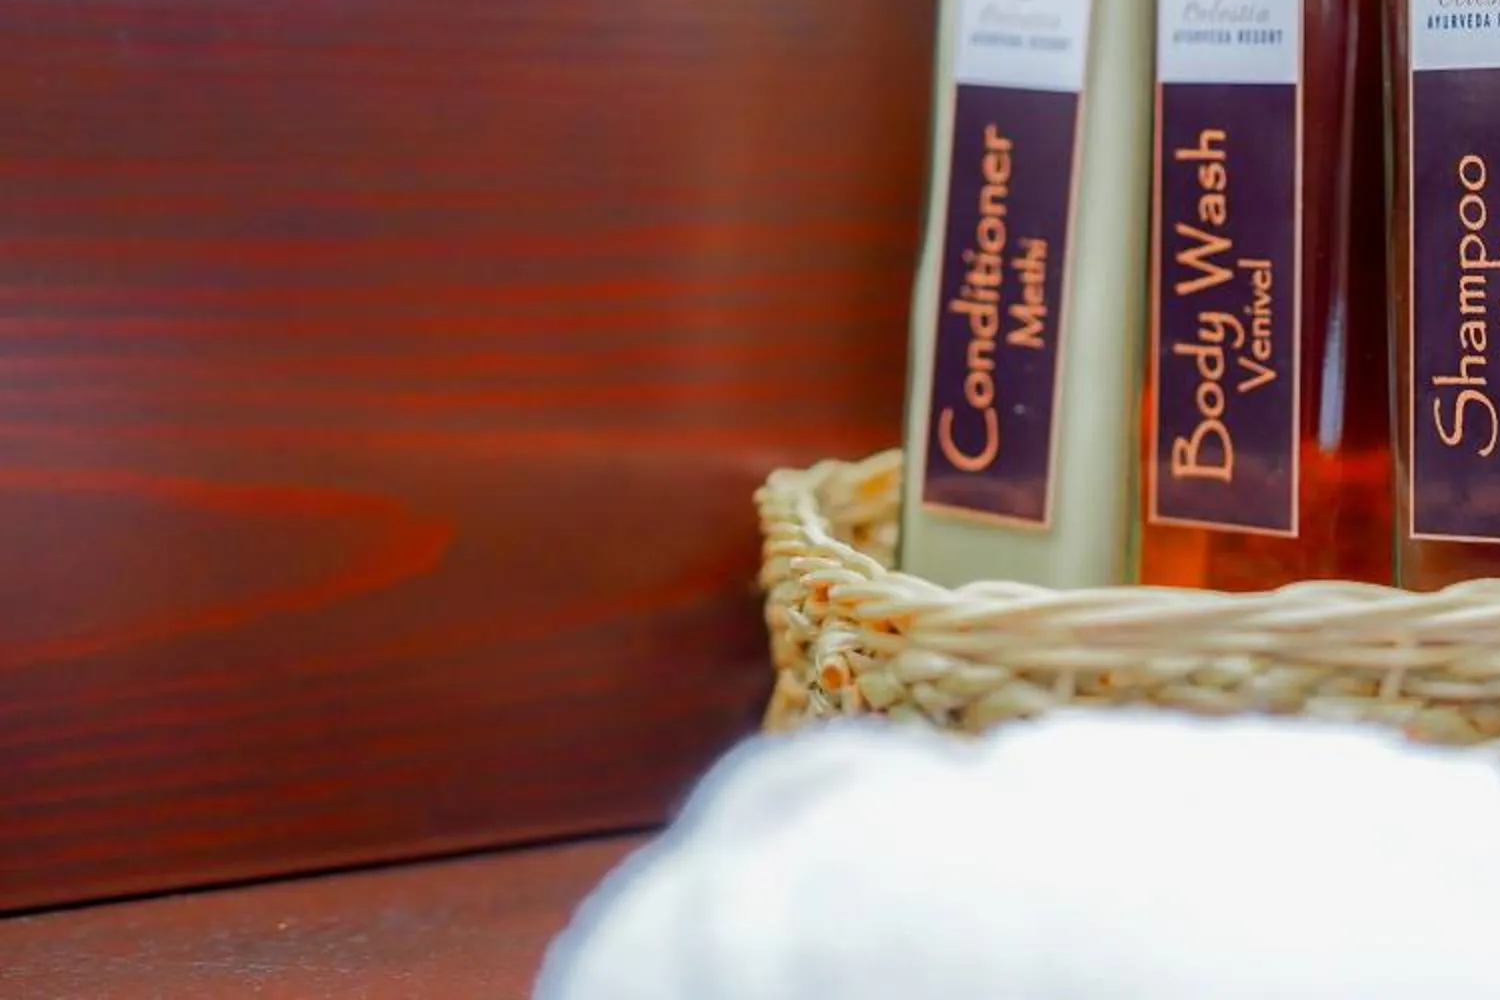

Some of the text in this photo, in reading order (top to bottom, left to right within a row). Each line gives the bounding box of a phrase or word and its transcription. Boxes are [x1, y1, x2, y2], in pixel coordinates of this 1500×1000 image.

[1427, 13, 1491, 30] AYURVEDA
[938, 124, 1013, 472] Conditioner
[1007, 237, 1049, 350] Methi
[1170, 127, 1246, 483] Body Wash
[1236, 258, 1277, 393] Venivel
